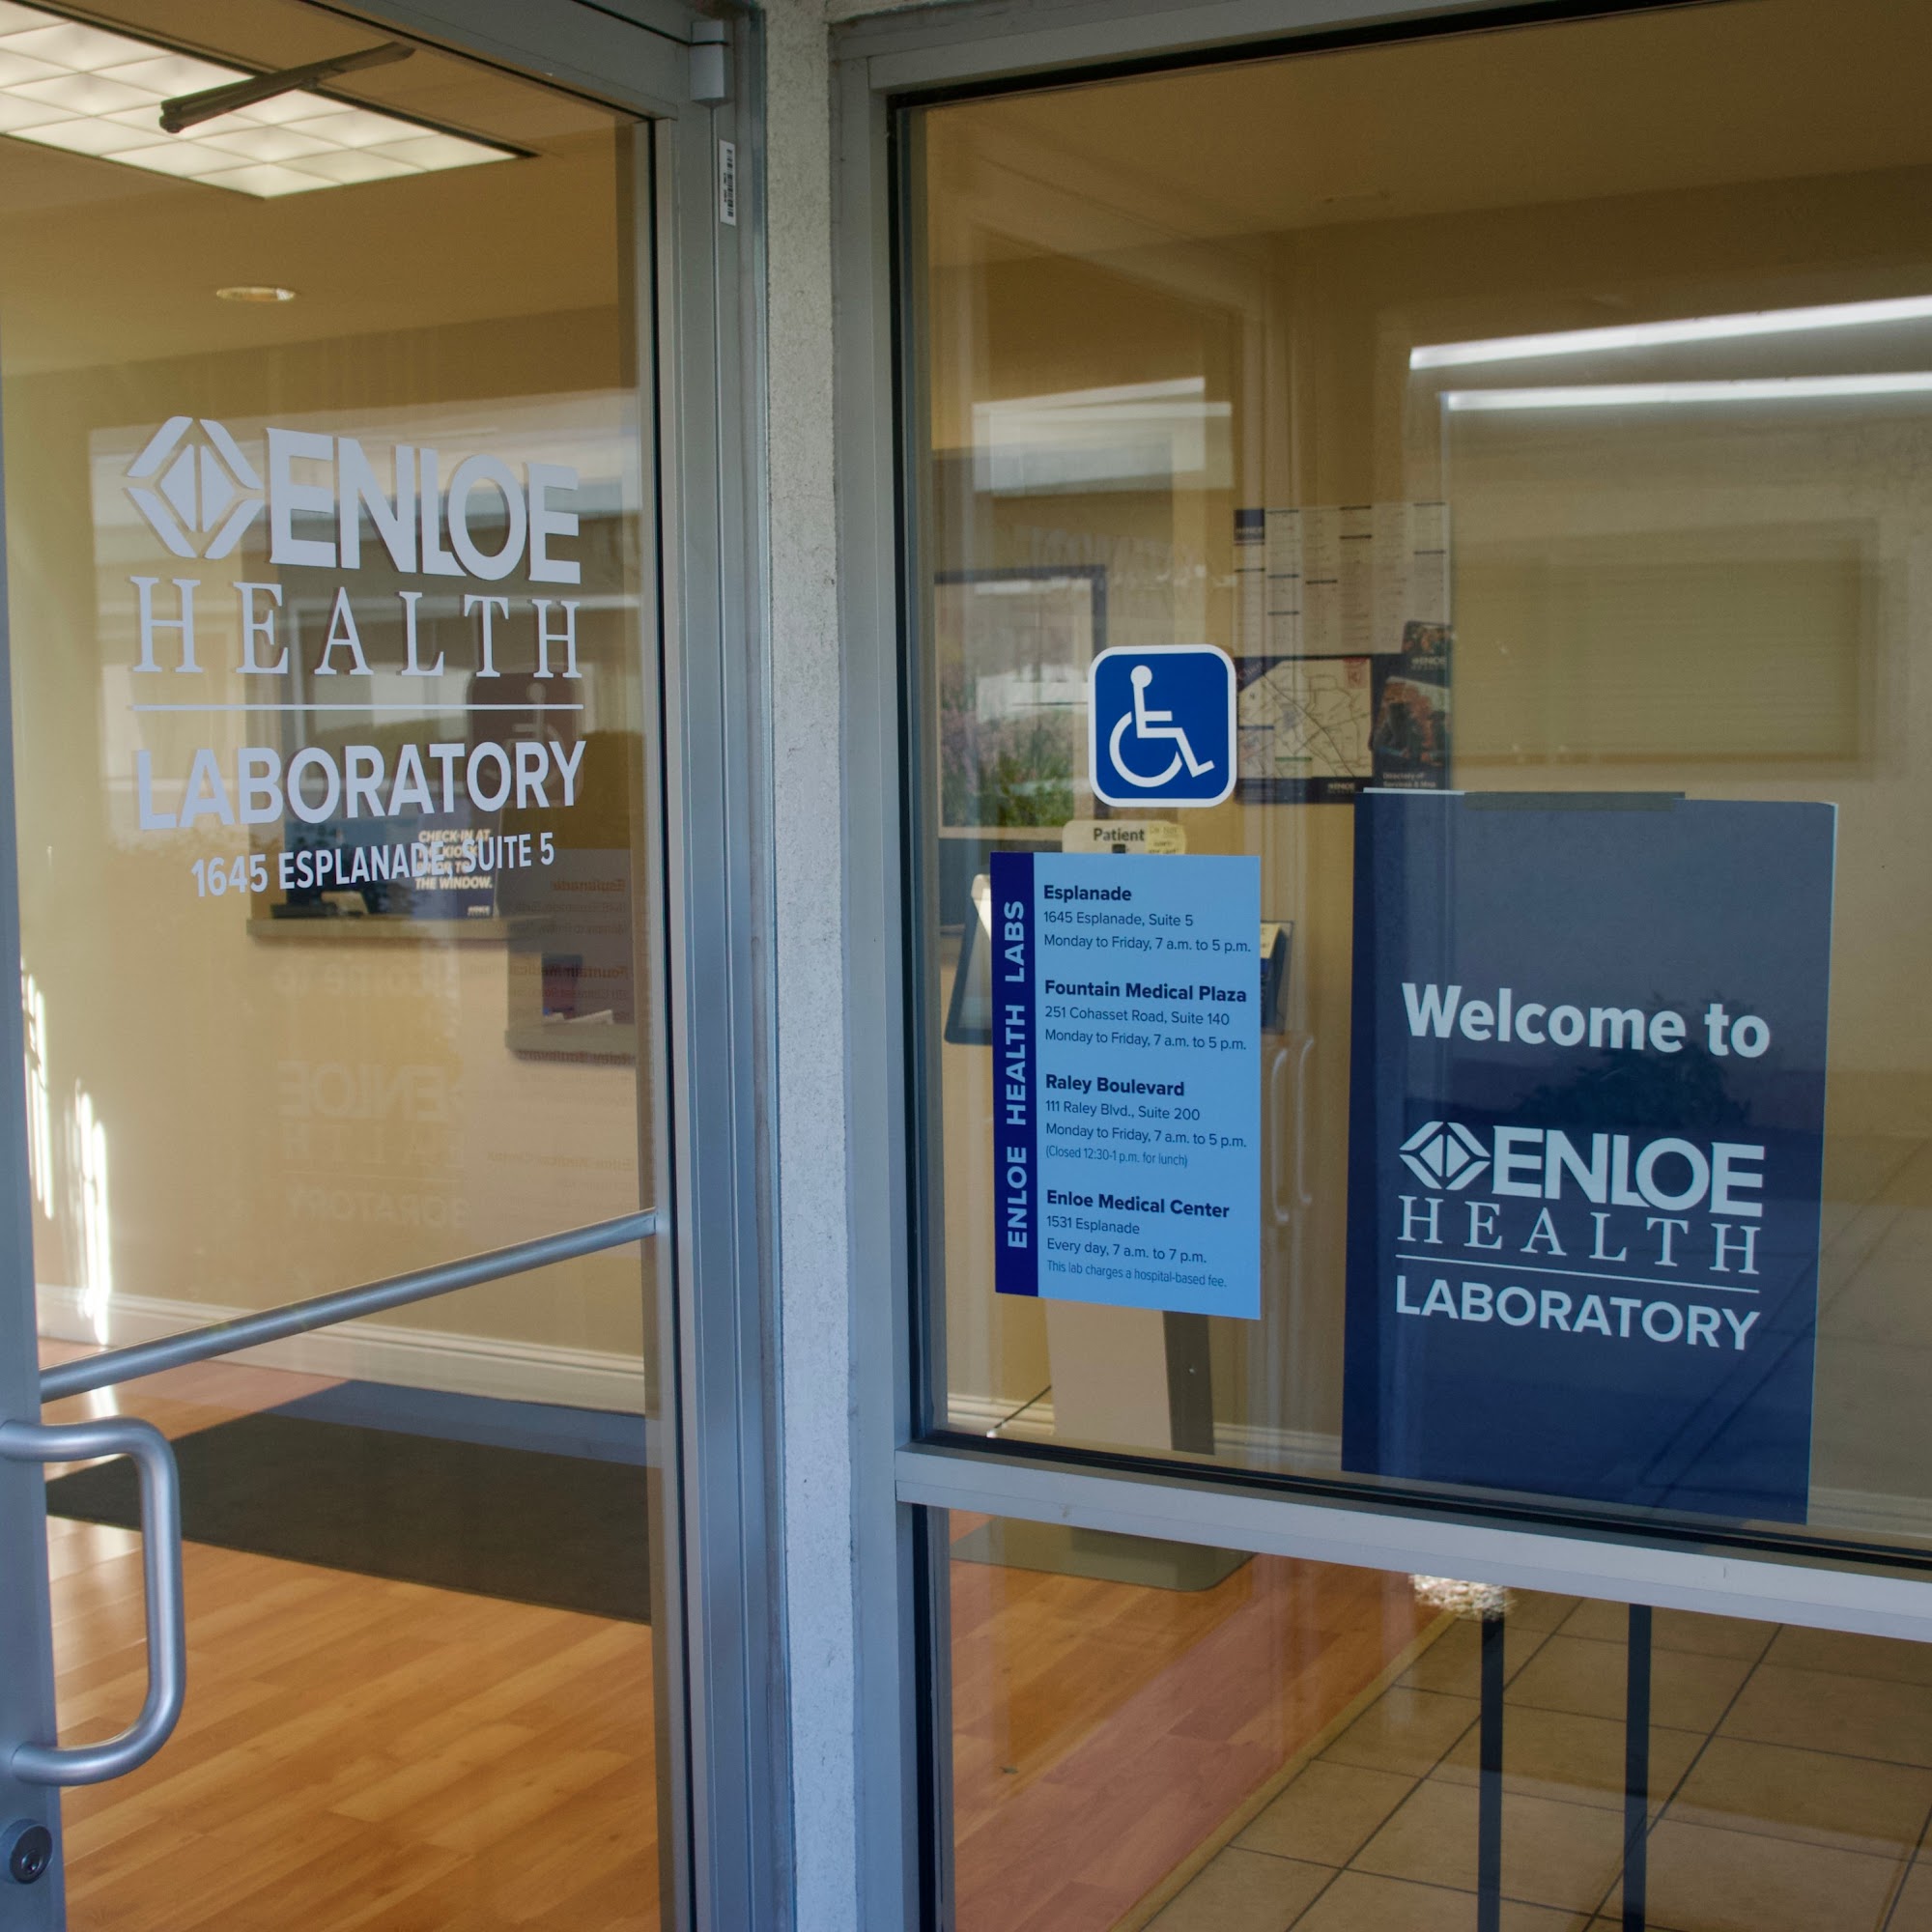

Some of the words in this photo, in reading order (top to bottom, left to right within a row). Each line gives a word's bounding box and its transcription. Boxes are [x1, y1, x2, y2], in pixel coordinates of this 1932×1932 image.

[266, 427, 580, 583] ENLOE
[129, 576, 582, 678] HEALTH
[136, 741, 585, 830] LABORATORY
[476, 829, 491, 842] AT
[1094, 828, 1145, 840] Patient
[443, 844, 477, 858] KIOK
[191, 854, 268, 897] 1645
[279, 842, 454, 890] ESPLANADE,
[463, 834, 531, 871] SUITE
[540, 832, 554, 866] 5
[415, 877, 437, 890] THE
[440, 876, 493, 889] WINDOW.
[1043, 885, 1132, 903] Esplanade
[1043, 911, 1072, 923] 1645
[1077, 912, 1145, 927] Esplanade,
[1149, 913, 1180, 926] Suite
[1185, 915, 1193, 926] 5
[1005, 900, 1024, 982] LABS
[1044, 934, 1093, 950] Monday
[1096, 935, 1108, 948] to
[1112, 936, 1151, 951] Friday,
[1155, 938, 1163, 950] 7
[1167, 941, 1192, 951] a.m.
[1196, 939, 1208, 951] to
[1212, 939, 1220, 952] 5
[1225, 942, 1251, 953] p.m.
[1045, 980, 1120, 997] Fountain
[1126, 982, 1193, 1000] Medical
[1199, 986, 1246, 1002] Plaza
[1045, 1006, 1065, 1018] 251
[1069, 1007, 1128, 1021] Cohasset
[1132, 1010, 1167, 1024] Road,
[1171, 1011, 1203, 1024] Suite
[1208, 1013, 1230, 1025] 140
[1402, 982, 1686, 1053] Welcome
[1704, 1004, 1770, 1058] to
[1045, 1029, 1093, 1043] Monday
[1096, 1031, 1108, 1043] to
[1112, 1032, 1151, 1047] Friday,
[1154, 1035, 1161, 1045] 7
[1165, 1037, 1189, 1047] a.m.
[1193, 1036, 1205, 1048] to
[1209, 1037, 1216, 1048] 5
[1220, 1039, 1246, 1051] p.m.
[1006, 1006, 1027, 1125] HEALTH
[1046, 1074, 1092, 1094] Raley
[1097, 1077, 1184, 1096] Boulevard
[1046, 1100, 1060, 1112] 111
[1064, 1101, 1096, 1117] Raley
[1101, 1104, 1134, 1118] Blvd.,
[1138, 1106, 1170, 1119] Suite
[1174, 1108, 1200, 1121] 200
[1046, 1123, 1094, 1139] Monday
[1096, 1126, 1108, 1138] to
[1112, 1127, 1151, 1143] Friday,
[1154, 1130, 1161, 1142] 7
[1165, 1133, 1189, 1144] a.m.
[1193, 1133, 1205, 1145] to
[1209, 1133, 1216, 1146] 5
[1220, 1136, 1246, 1149] p.m.
[1046, 1145, 1081, 1158] (Closed
[1084, 1148, 1117, 1161] 12:30-1
[1120, 1151, 1140, 1163] p.m.
[1142, 1152, 1156, 1164] for
[1158, 1153, 1187, 1167] lunch)
[1492, 1125, 1765, 1217] ENLOE
[1007, 1146, 1028, 1248] ENLOE
[1047, 1190, 1093, 1207] Enloe
[1099, 1193, 1165, 1212] Medical
[1170, 1200, 1230, 1218] Center
[1047, 1215, 1071, 1228] 1531
[1076, 1217, 1140, 1235] Esplanade
[1397, 1195, 1761, 1274] HEALTH
[1047, 1238, 1080, 1254] Every
[1084, 1241, 1109, 1256] day,
[1113, 1244, 1120, 1255] 7
[1123, 1247, 1149, 1258] a.m.
[1152, 1248, 1165, 1260] to
[1169, 1249, 1177, 1261] 7
[1180, 1251, 1207, 1264] p.m.
[1047, 1261, 1065, 1272] This
[1069, 1263, 1082, 1273] lab
[1086, 1264, 1122, 1279] charges
[1125, 1270, 1131, 1279] a
[1134, 1268, 1205, 1286] hospital-based
[1208, 1275, 1227, 1287] fee.
[1396, 1275, 1760, 1350] LABORATORY
